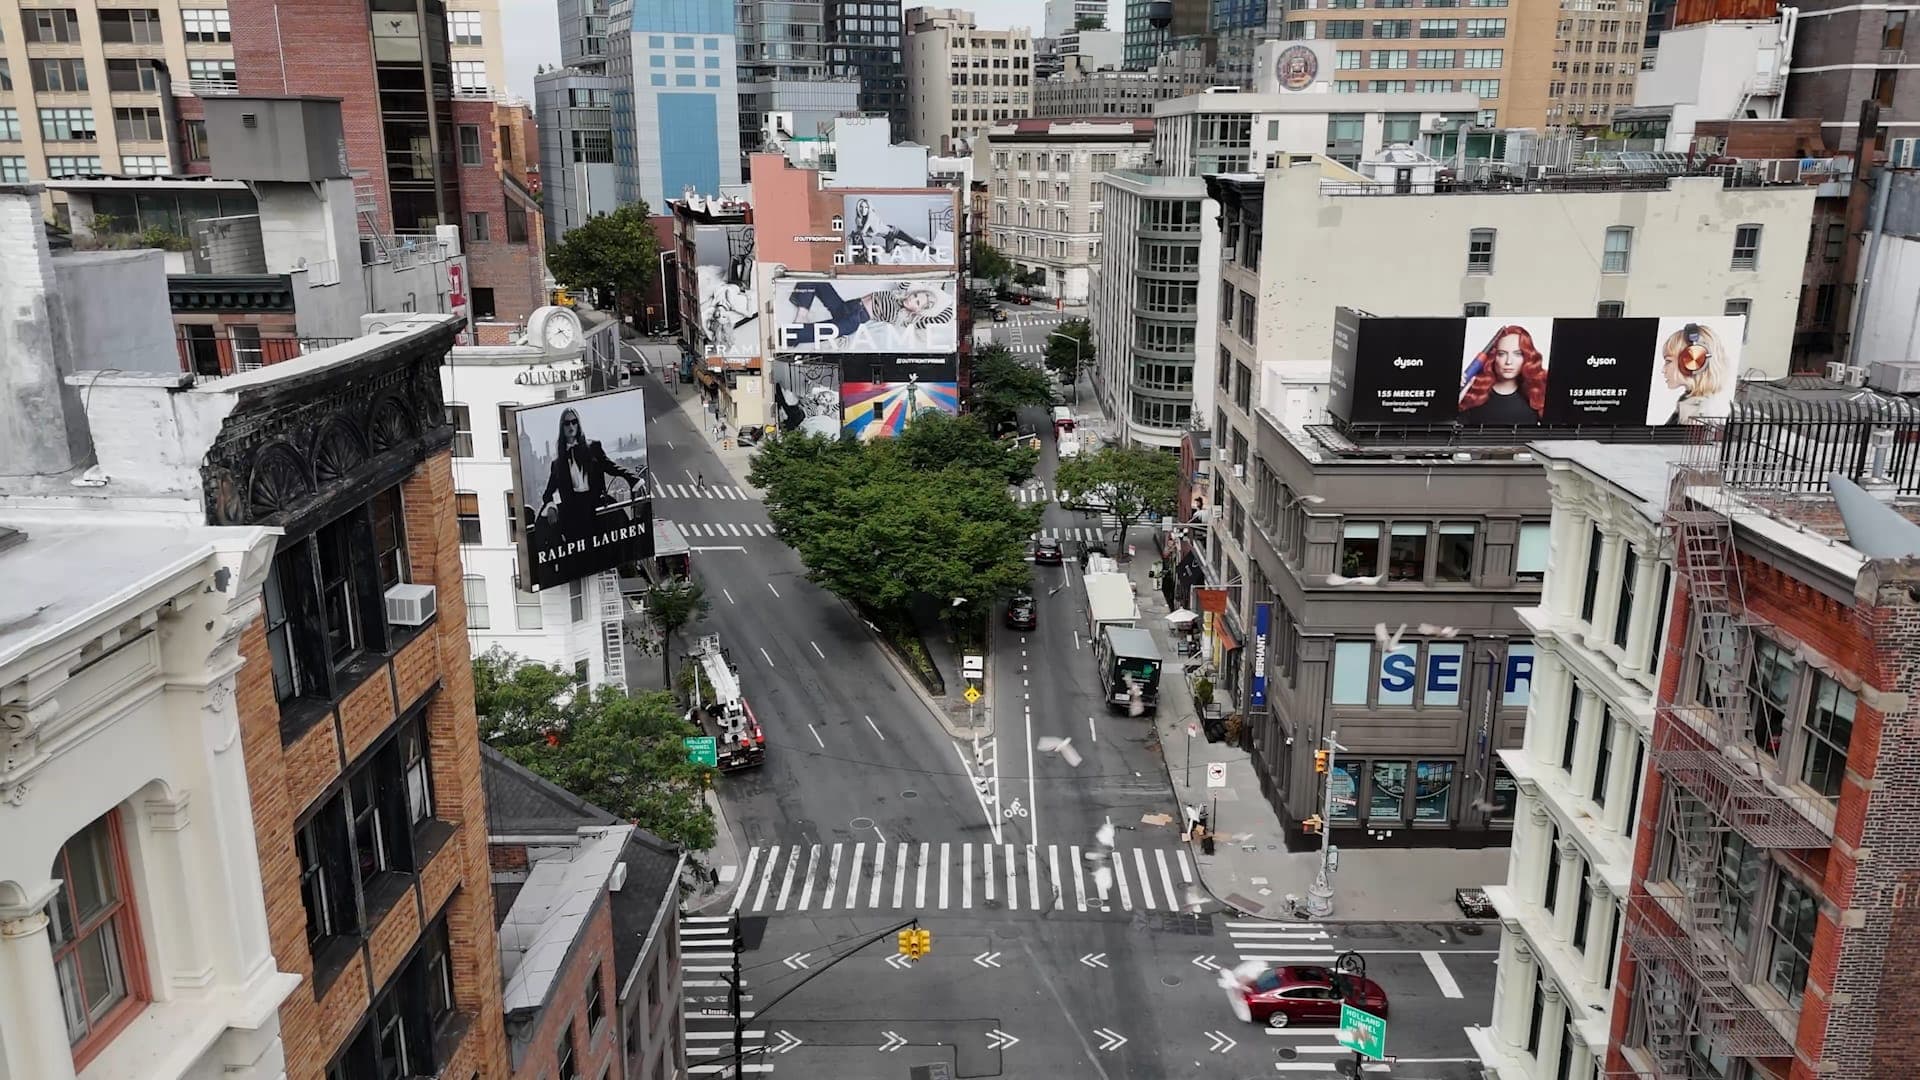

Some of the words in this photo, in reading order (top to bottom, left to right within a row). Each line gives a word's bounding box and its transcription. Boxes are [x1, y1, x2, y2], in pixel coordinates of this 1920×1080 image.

[848, 245, 952, 265] FRAME
[780, 322, 951, 350] FRAME
[1393, 356, 1424, 369] dyson
[1586, 354, 1617, 368] dyson
[518, 370, 567, 385] OLIVER
[1377, 390, 1392, 398] 155
[1393, 390, 1425, 398] MERCER
[1425, 390, 1436, 398] ST
[1569, 388, 1584, 397] 155
[1584, 388, 1617, 397] MERCER
[1617, 388, 1628, 397] ST
[538, 539, 586, 564] RALPH
[593, 522, 646, 547] LAUREN
[1346, 1009, 1381, 1027] HOLLAND
